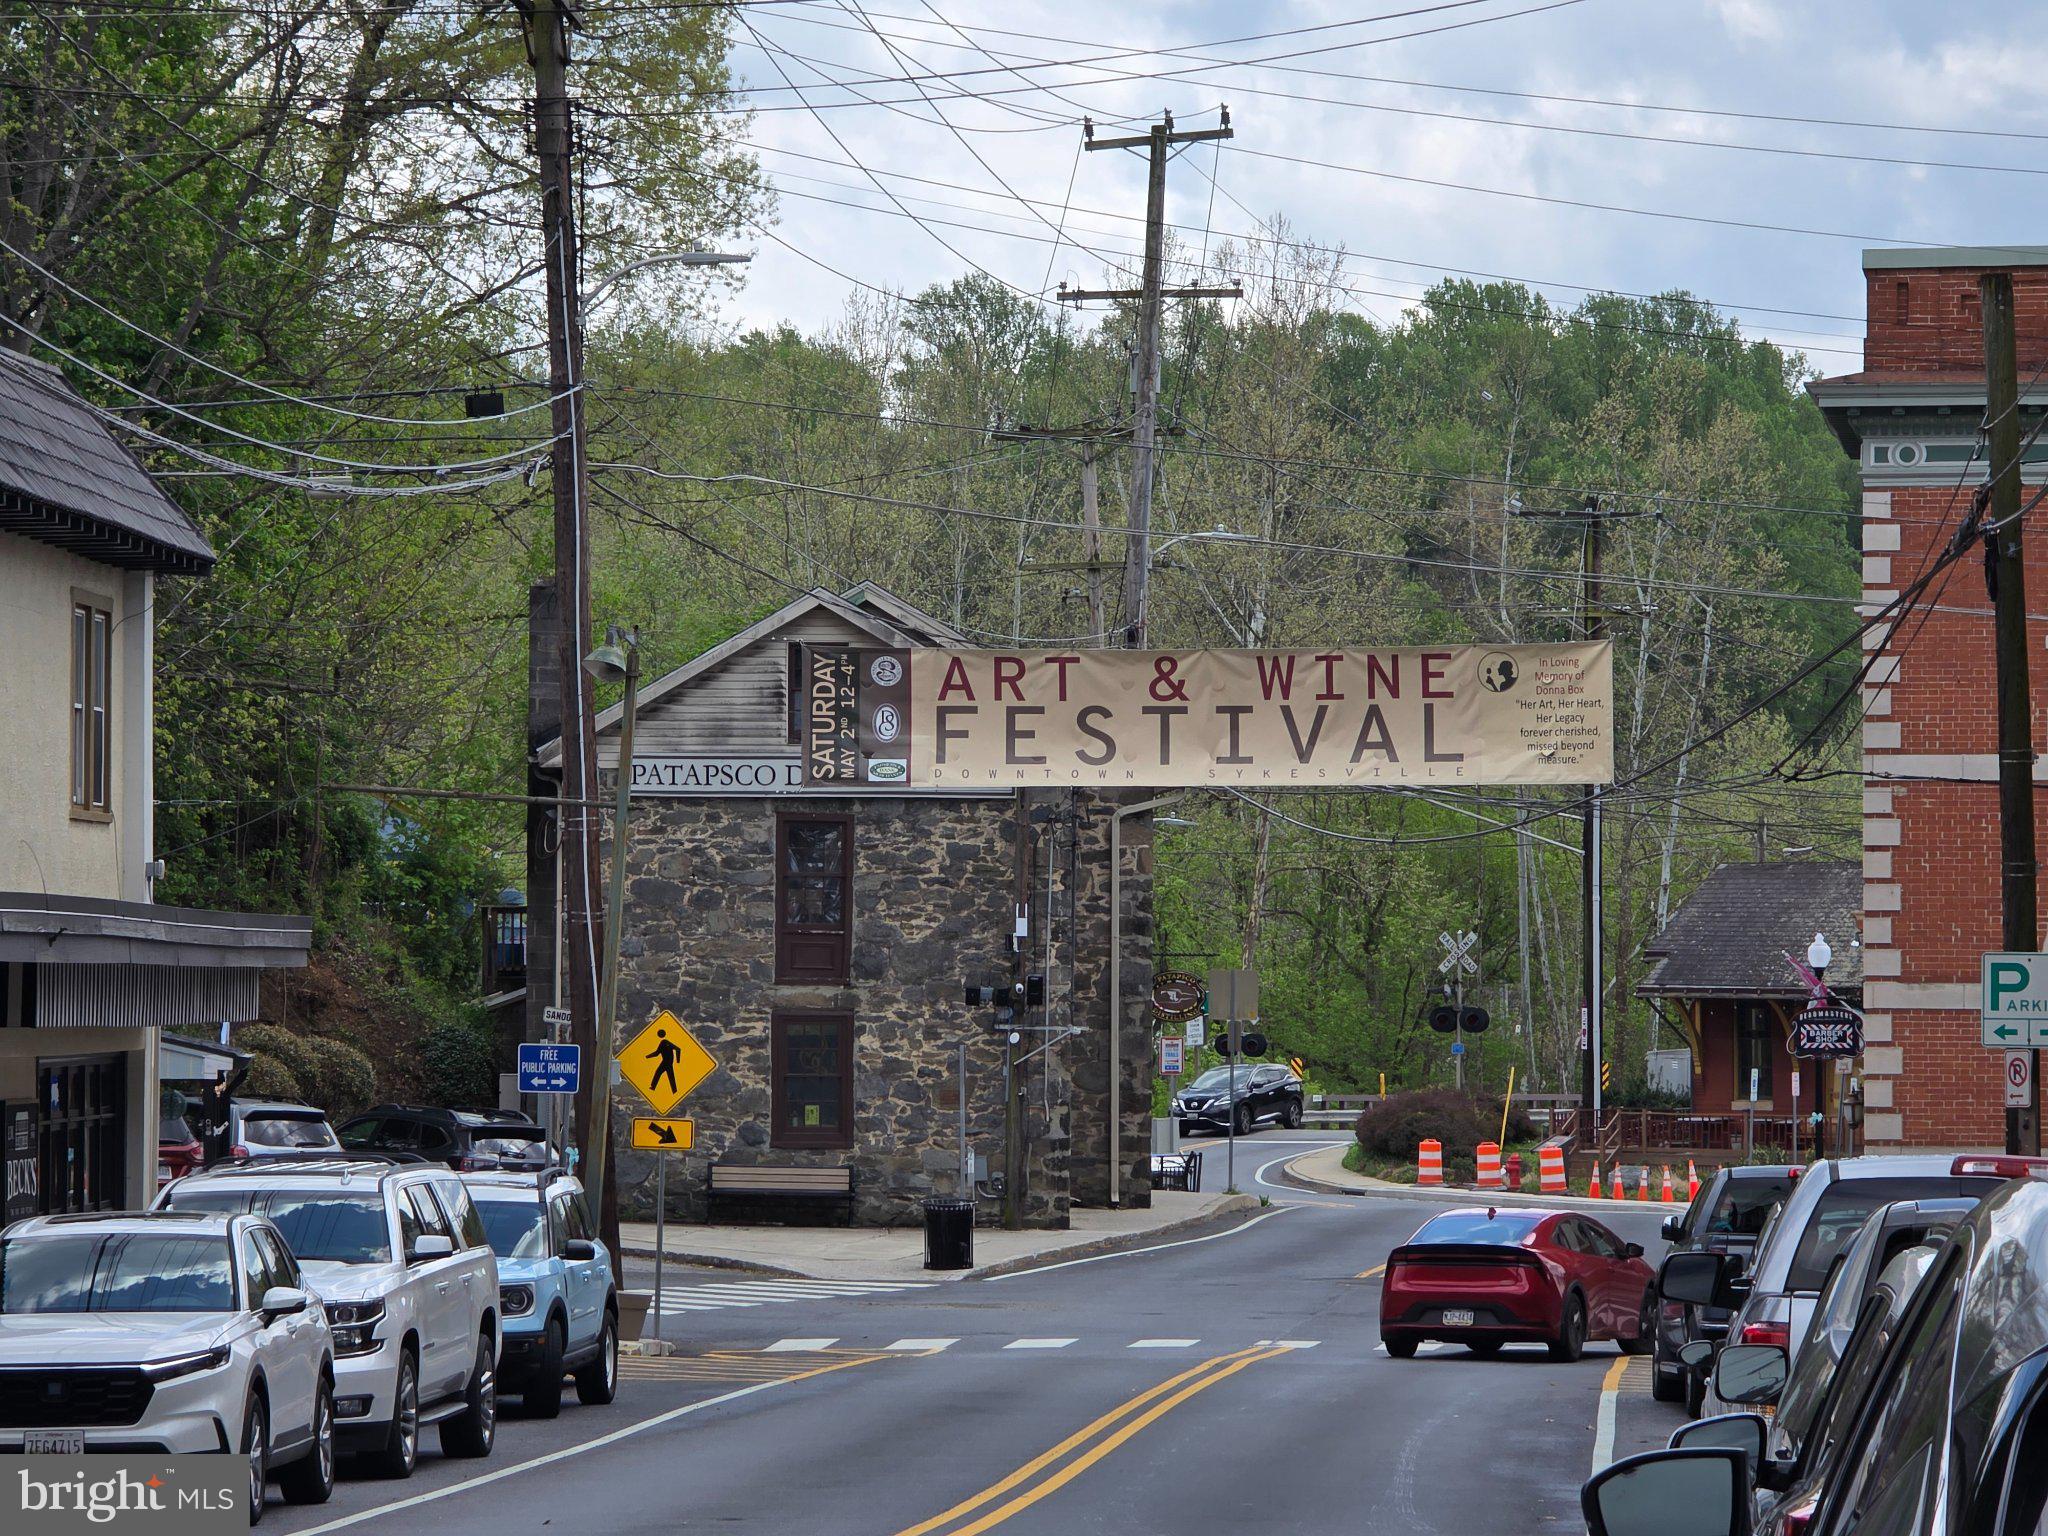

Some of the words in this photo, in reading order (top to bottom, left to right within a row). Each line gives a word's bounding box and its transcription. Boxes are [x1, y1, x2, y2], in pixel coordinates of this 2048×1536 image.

[1540, 658, 1548, 667] In
[1550, 657, 1579, 668] Loving
[937, 655, 1081, 702] ART
[1148, 655, 1191, 702] &
[1256, 652, 1454, 701] WINE
[1535, 671, 1573, 682] Memory
[1575, 670, 1585, 680] of
[1536, 685, 1565, 695] Donna
[1568, 685, 1584, 694] Box
[1539, 699, 1556, 710] Art,
[1559, 699, 1574, 708] Her
[1577, 698, 1604, 709] Heart,
[812, 653, 836, 779] SATURDAY
[1536, 713, 1552, 723] Her
[1555, 714, 1585, 724] Legacy
[841, 717, 855, 740] 2ND
[936, 704, 1464, 765] FESTIVAL
[1520, 727, 1552, 738] forever
[1554, 726, 1600, 737] cherished,
[1527, 741, 1558, 751] missed
[1560, 740, 1594, 751] beyond
[841, 748, 855, 778] MAY
[631, 764, 776, 786] PATAPSCO
[934, 768, 1134, 780] DOWNTOWN
[1208, 766, 1464, 779] SYKESVILLE
[540, 1050, 558, 1060] FREE
[521, 1062, 545, 1073] PUBLIC
[547, 1063, 576, 1074] PARKING
